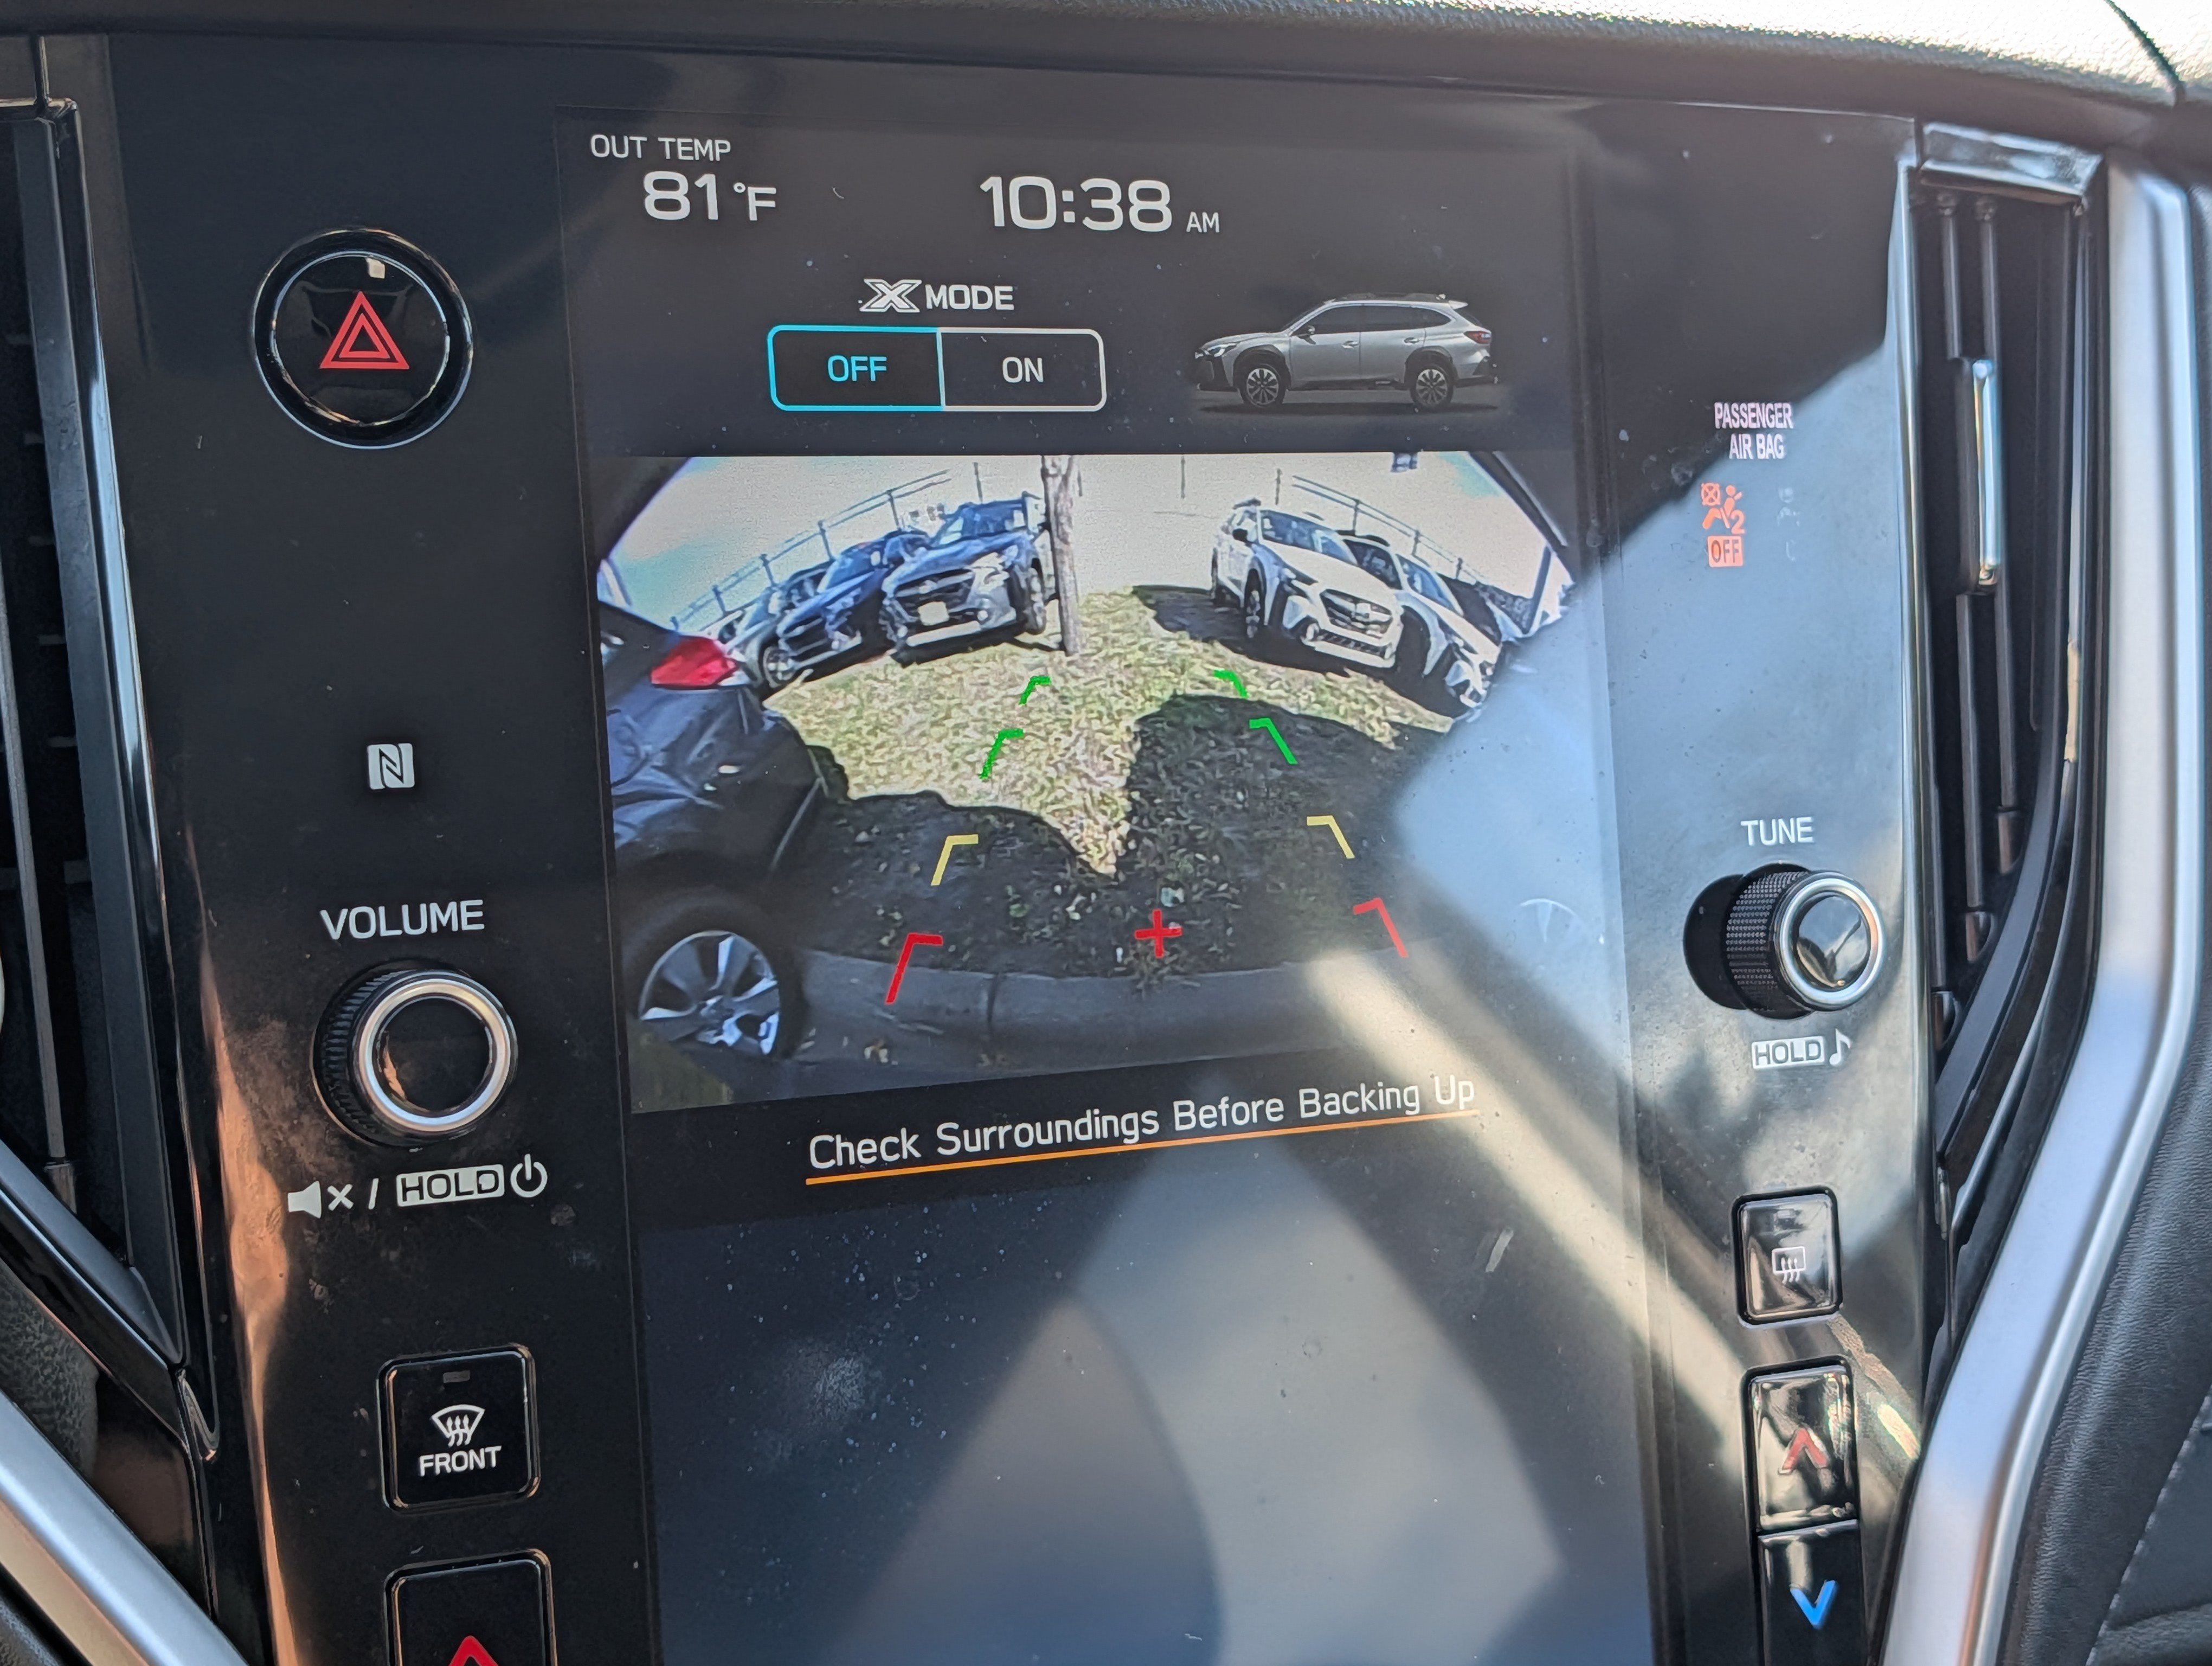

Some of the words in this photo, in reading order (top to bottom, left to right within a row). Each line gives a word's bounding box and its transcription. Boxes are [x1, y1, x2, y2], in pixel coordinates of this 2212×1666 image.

[590, 134, 647, 158] OUT
[658, 137, 731, 162] TEMP
[980, 176, 1172, 232] 10:38
[1186, 212, 1220, 233] AM
[827, 355, 887, 382] OFF
[1002, 356, 1044, 383] ON
[1714, 402, 1794, 429] PASSENGER
[1729, 433, 1754, 459] AIR
[1756, 433, 1785, 459] BAG
[1711, 539, 1740, 563] OFF
[1740, 817, 1815, 846] TUNE
[320, 899, 485, 940] VOLUME
[1754, 1039, 1822, 1066] HOLD
[809, 1127, 922, 1169] Check
[936, 1108, 1160, 1156] Surroundings
[1173, 1096, 1284, 1131] Before
[1298, 1081, 1420, 1119] Backing
[1434, 1074, 1475, 1110] Up
[400, 1167, 501, 1203] HOLD
[419, 1445, 502, 1477] FRONT
